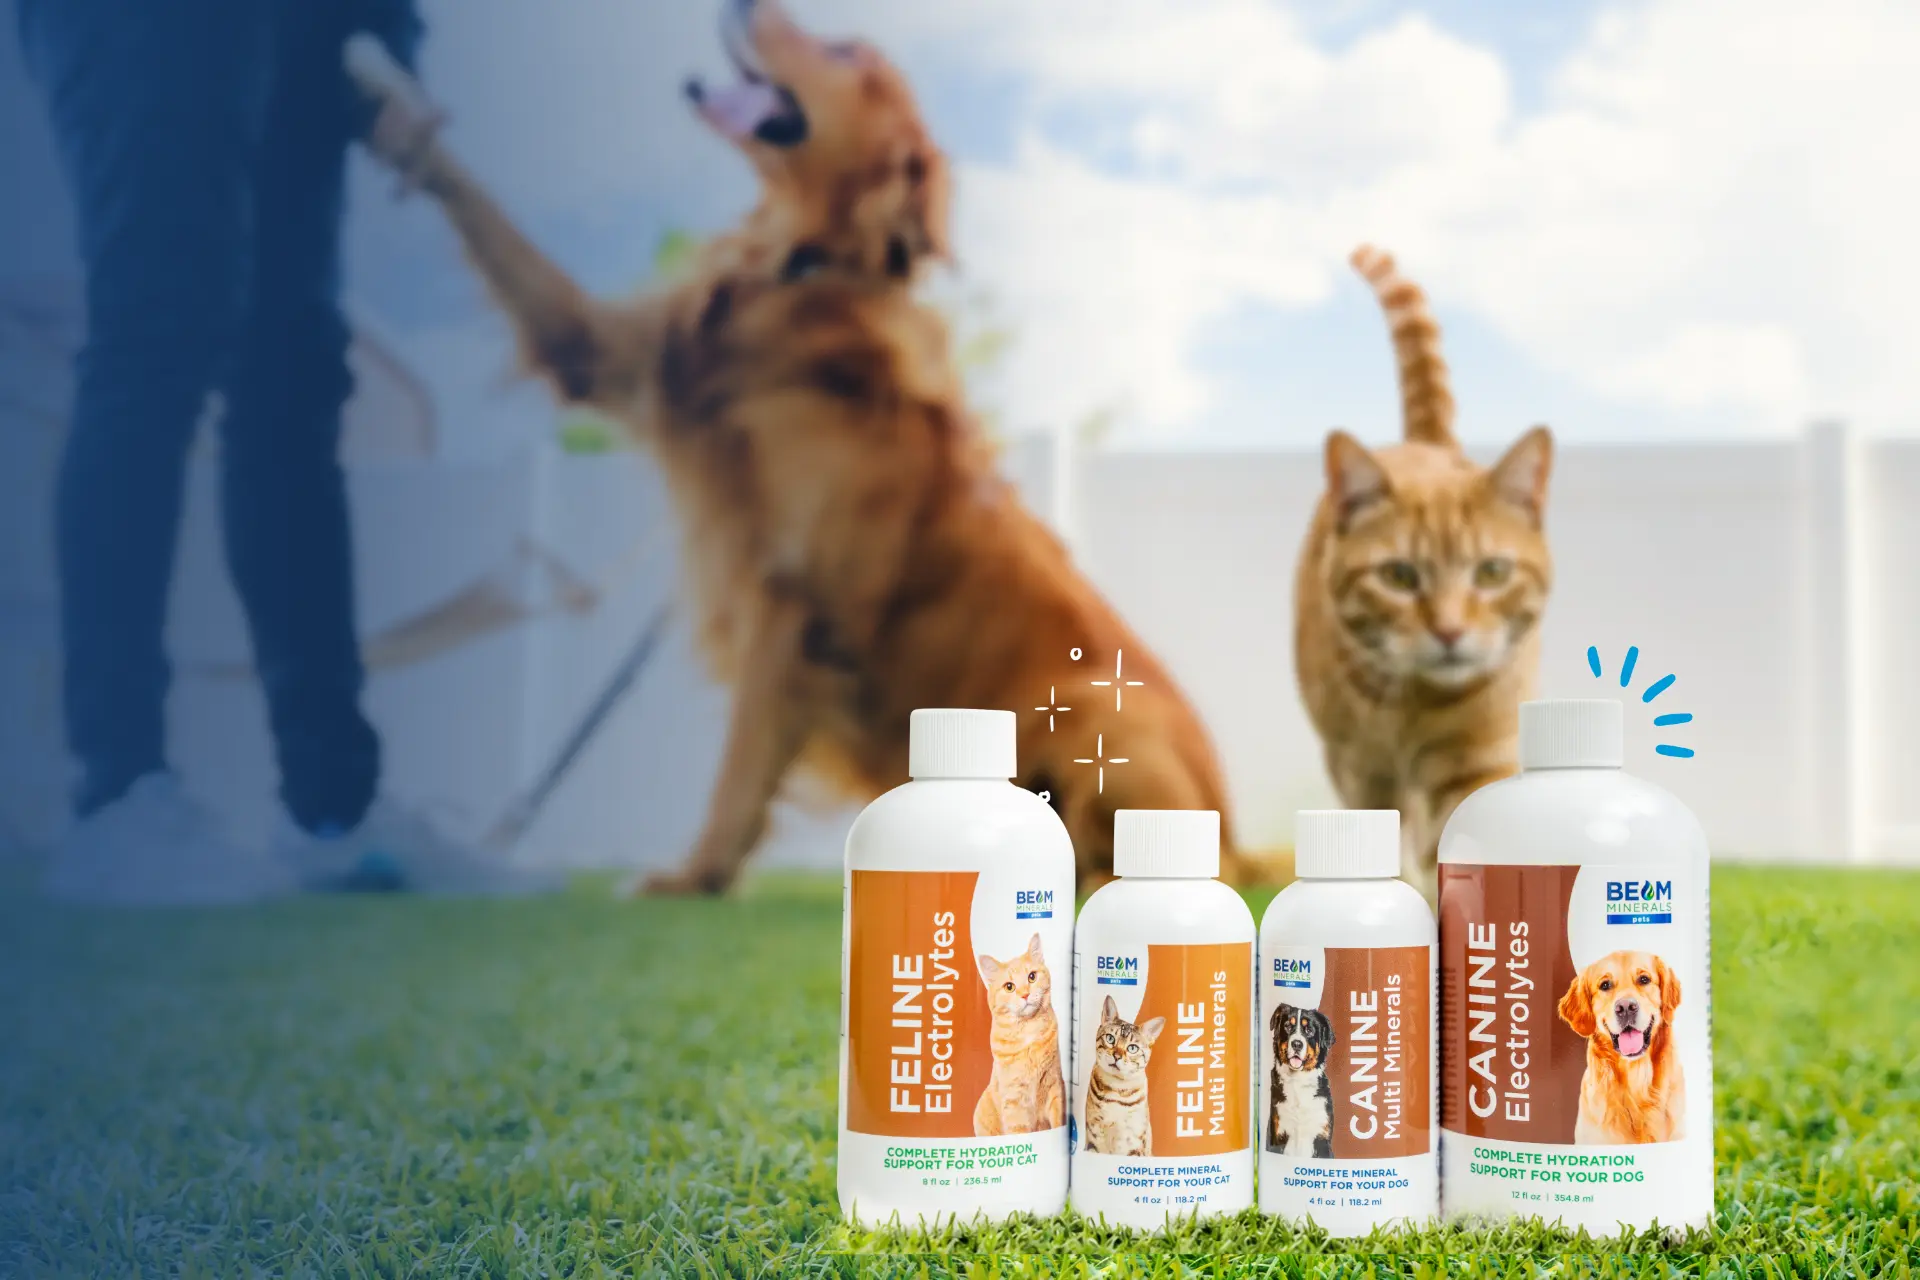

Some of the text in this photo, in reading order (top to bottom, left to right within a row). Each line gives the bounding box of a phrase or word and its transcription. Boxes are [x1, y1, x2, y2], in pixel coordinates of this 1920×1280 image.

[1606, 902, 1672, 912] MINERALS
[924, 911, 959, 1113] Electrolytes
[1468, 922, 1497, 1118] CANINE
[1505, 921, 1534, 1122] Electrolytes
[890, 954, 924, 1113] FELINE
[1208, 970, 1226, 1136] Multi Minerals
[1383, 974, 1401, 1140] Multi Minerals
[1176, 1002, 1205, 1138] FELINE
[1350, 990, 1378, 1140] CANINE
[887, 1143, 1033, 1158] COMPLETE HYDRATION
[1474, 1147, 1634, 1166] COMPLETE HYDRATION
[884, 1154, 1038, 1170] SUPPORT FOR YOUR CAT
[1118, 1165, 1222, 1175] COMPLETE MINERAL
[922, 1178, 928, 1186] 8
[964, 1177, 988, 1185] 236.5
[991, 1175, 1002, 1184] ml
[1108, 1174, 1231, 1187] SUPPORT FOR YOUR CAT
[1294, 1167, 1398, 1178] COMPLETE MINERAL
[1470, 1162, 1644, 1183] SUPPORT FOR YOUR DOG
[1283, 1177, 1408, 1190] SUPPORT FOR YOUR DOG
[1134, 1196, 1140, 1204] 4
[1175, 1195, 1195, 1203] 118.2
[1197, 1195, 1207, 1203] ml
[1309, 1197, 1315, 1205] 4
[1349, 1198, 1369, 1206] 118.2
[1371, 1198, 1382, 1206] ml
[1511, 1191, 1520, 1199] 12
[1554, 1194, 1580, 1202] 354.8
[1582, 1195, 1594, 1203] ml
